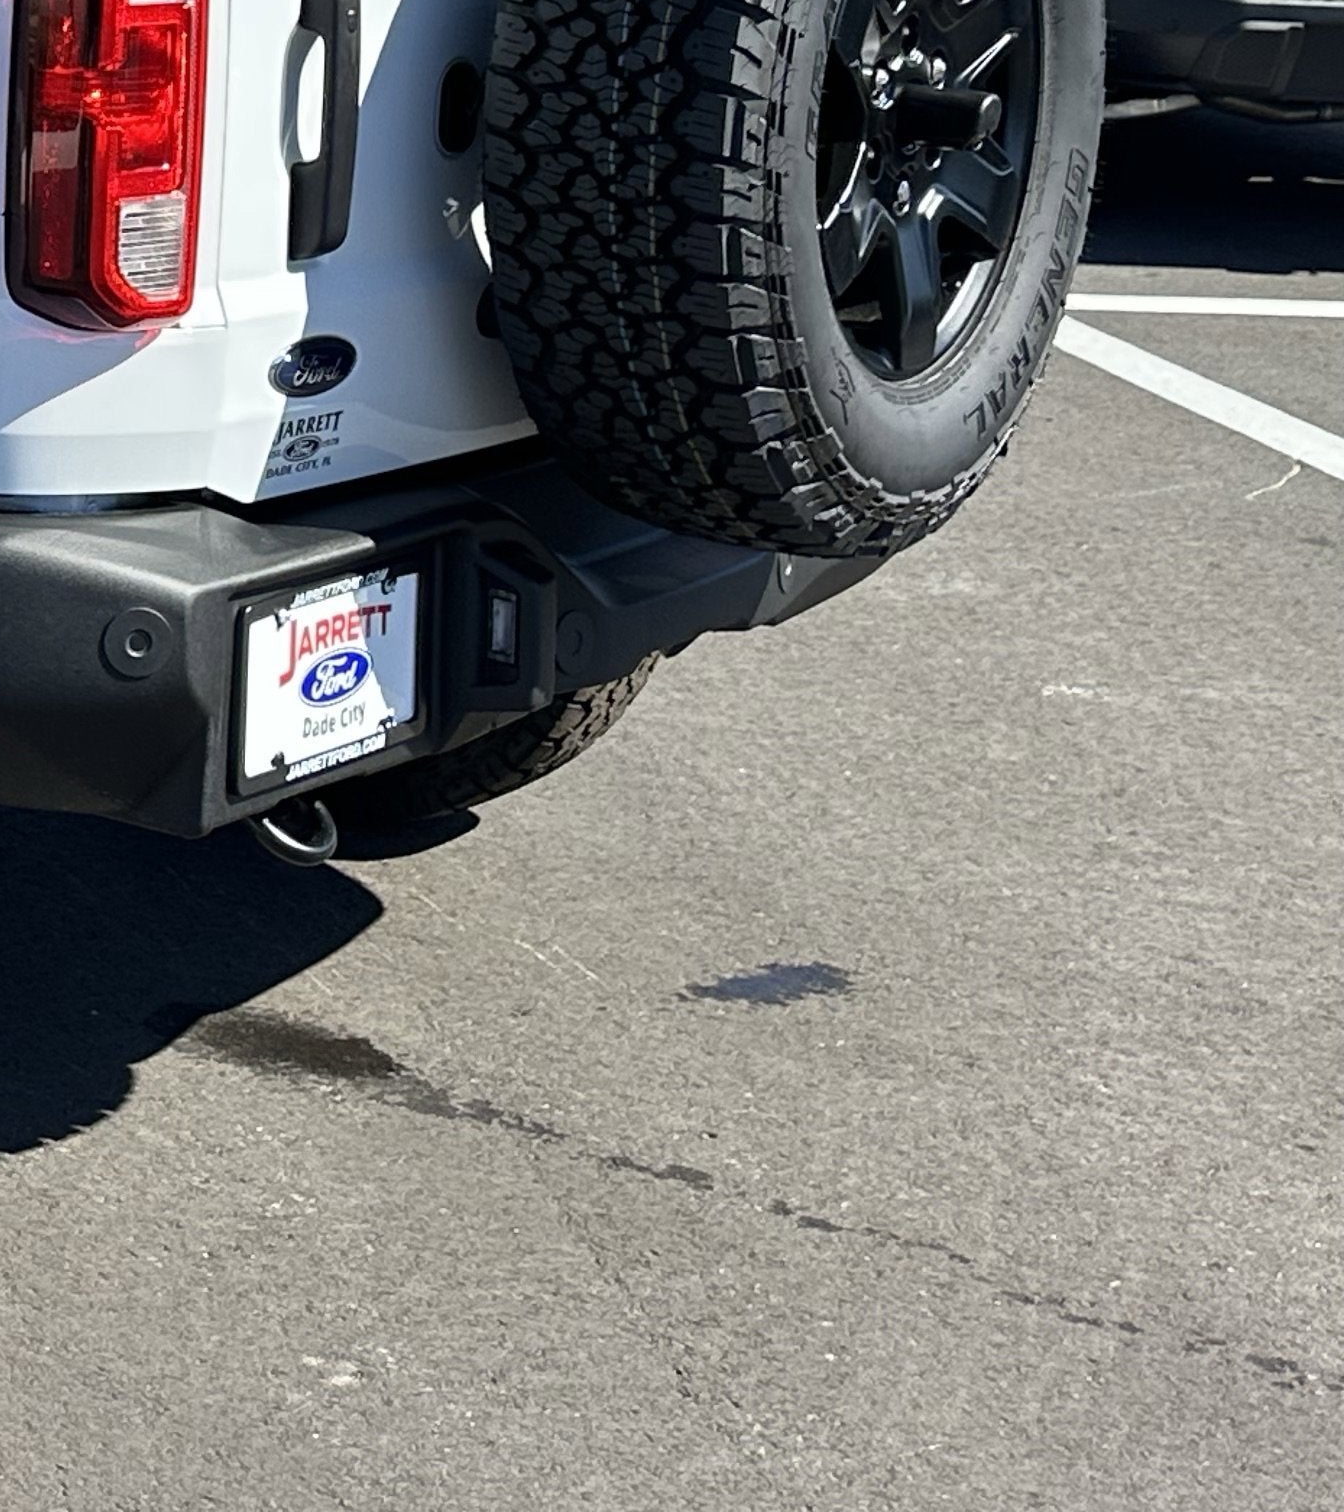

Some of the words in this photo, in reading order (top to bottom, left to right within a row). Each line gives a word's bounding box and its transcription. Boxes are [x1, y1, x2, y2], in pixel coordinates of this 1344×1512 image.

[962, 146, 1090, 442] GENERAL
[272, 409, 344, 447] JARRETT
[278, 603, 392, 688] JARRETT
[310, 655, 360, 701] Ford
[302, 711, 337, 740] Dade
[339, 701, 367, 727] City
